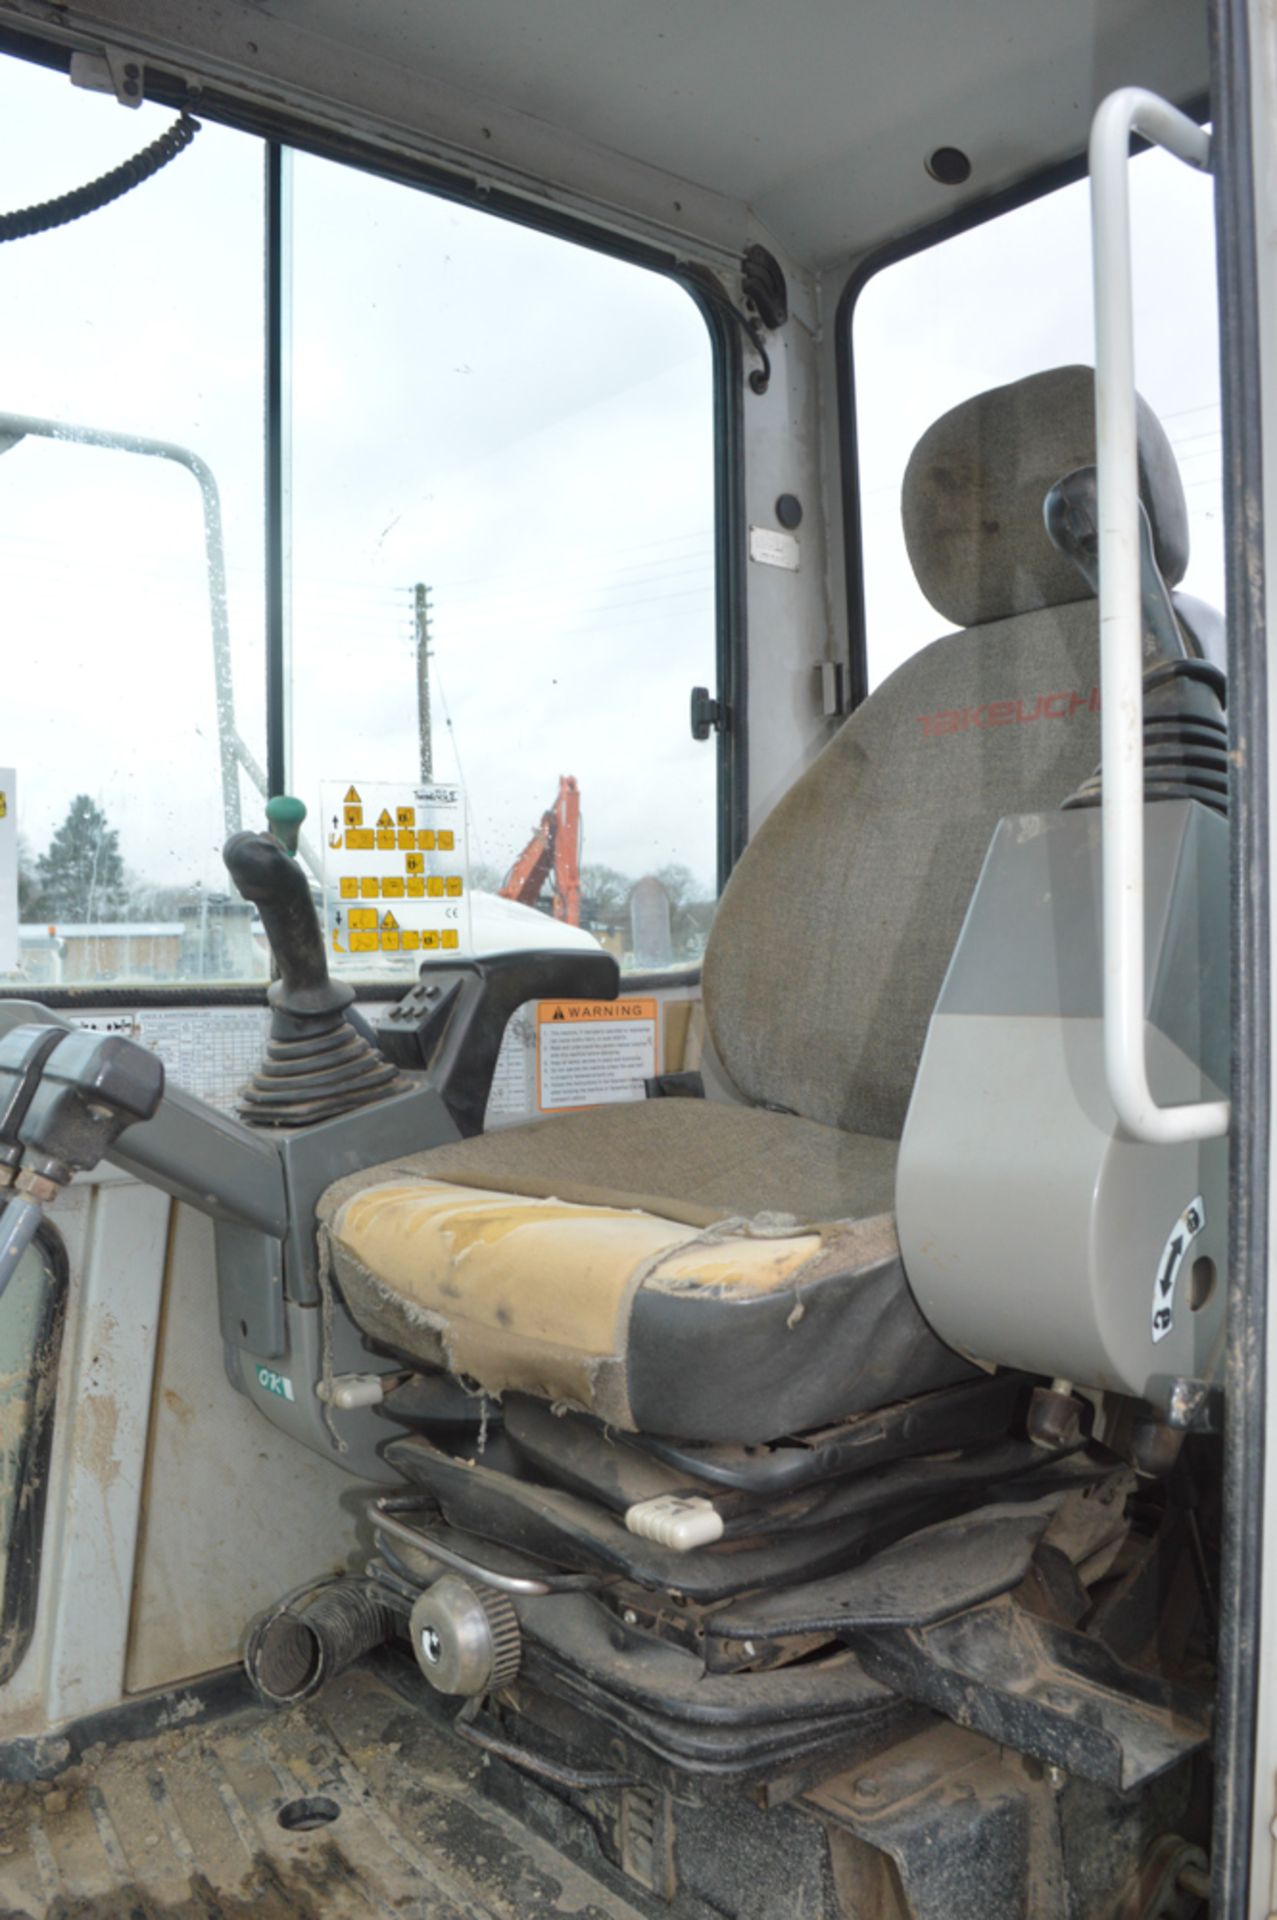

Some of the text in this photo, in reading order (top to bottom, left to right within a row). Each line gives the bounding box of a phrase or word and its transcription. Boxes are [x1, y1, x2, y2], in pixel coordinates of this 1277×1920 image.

[917, 687, 1101, 737] TAKEUCH
[568, 1004, 643, 1018] WARNING
[258, 1368, 282, 1395] OK
